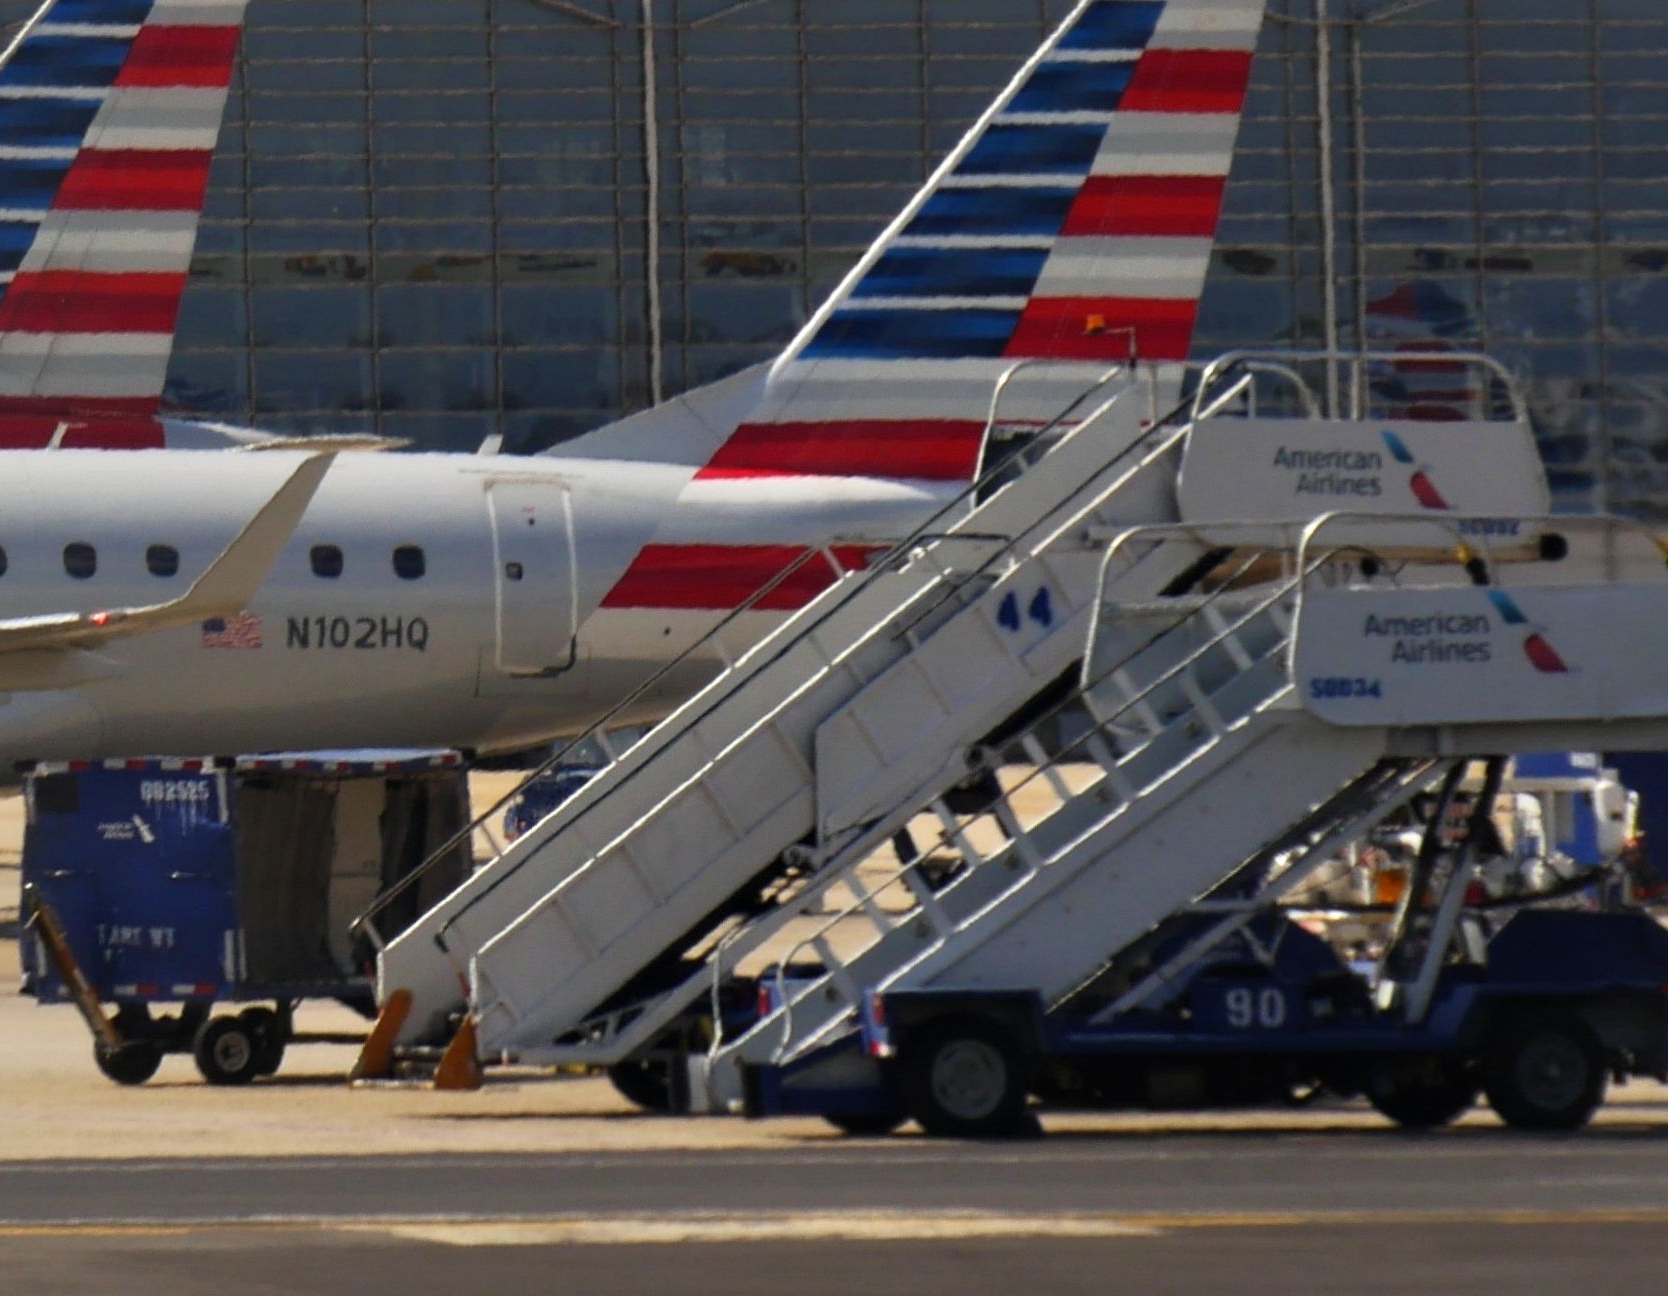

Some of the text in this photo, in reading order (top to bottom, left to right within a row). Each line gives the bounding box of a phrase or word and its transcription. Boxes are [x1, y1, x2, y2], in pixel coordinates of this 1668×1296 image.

[1273, 446, 1383, 470] American
[1295, 471, 1383, 497] Airlines
[286, 614, 429, 653] N102HQ
[1364, 613, 1491, 638] American
[1391, 638, 1492, 664] Airlines
[1225, 987, 1287, 1029] 90
